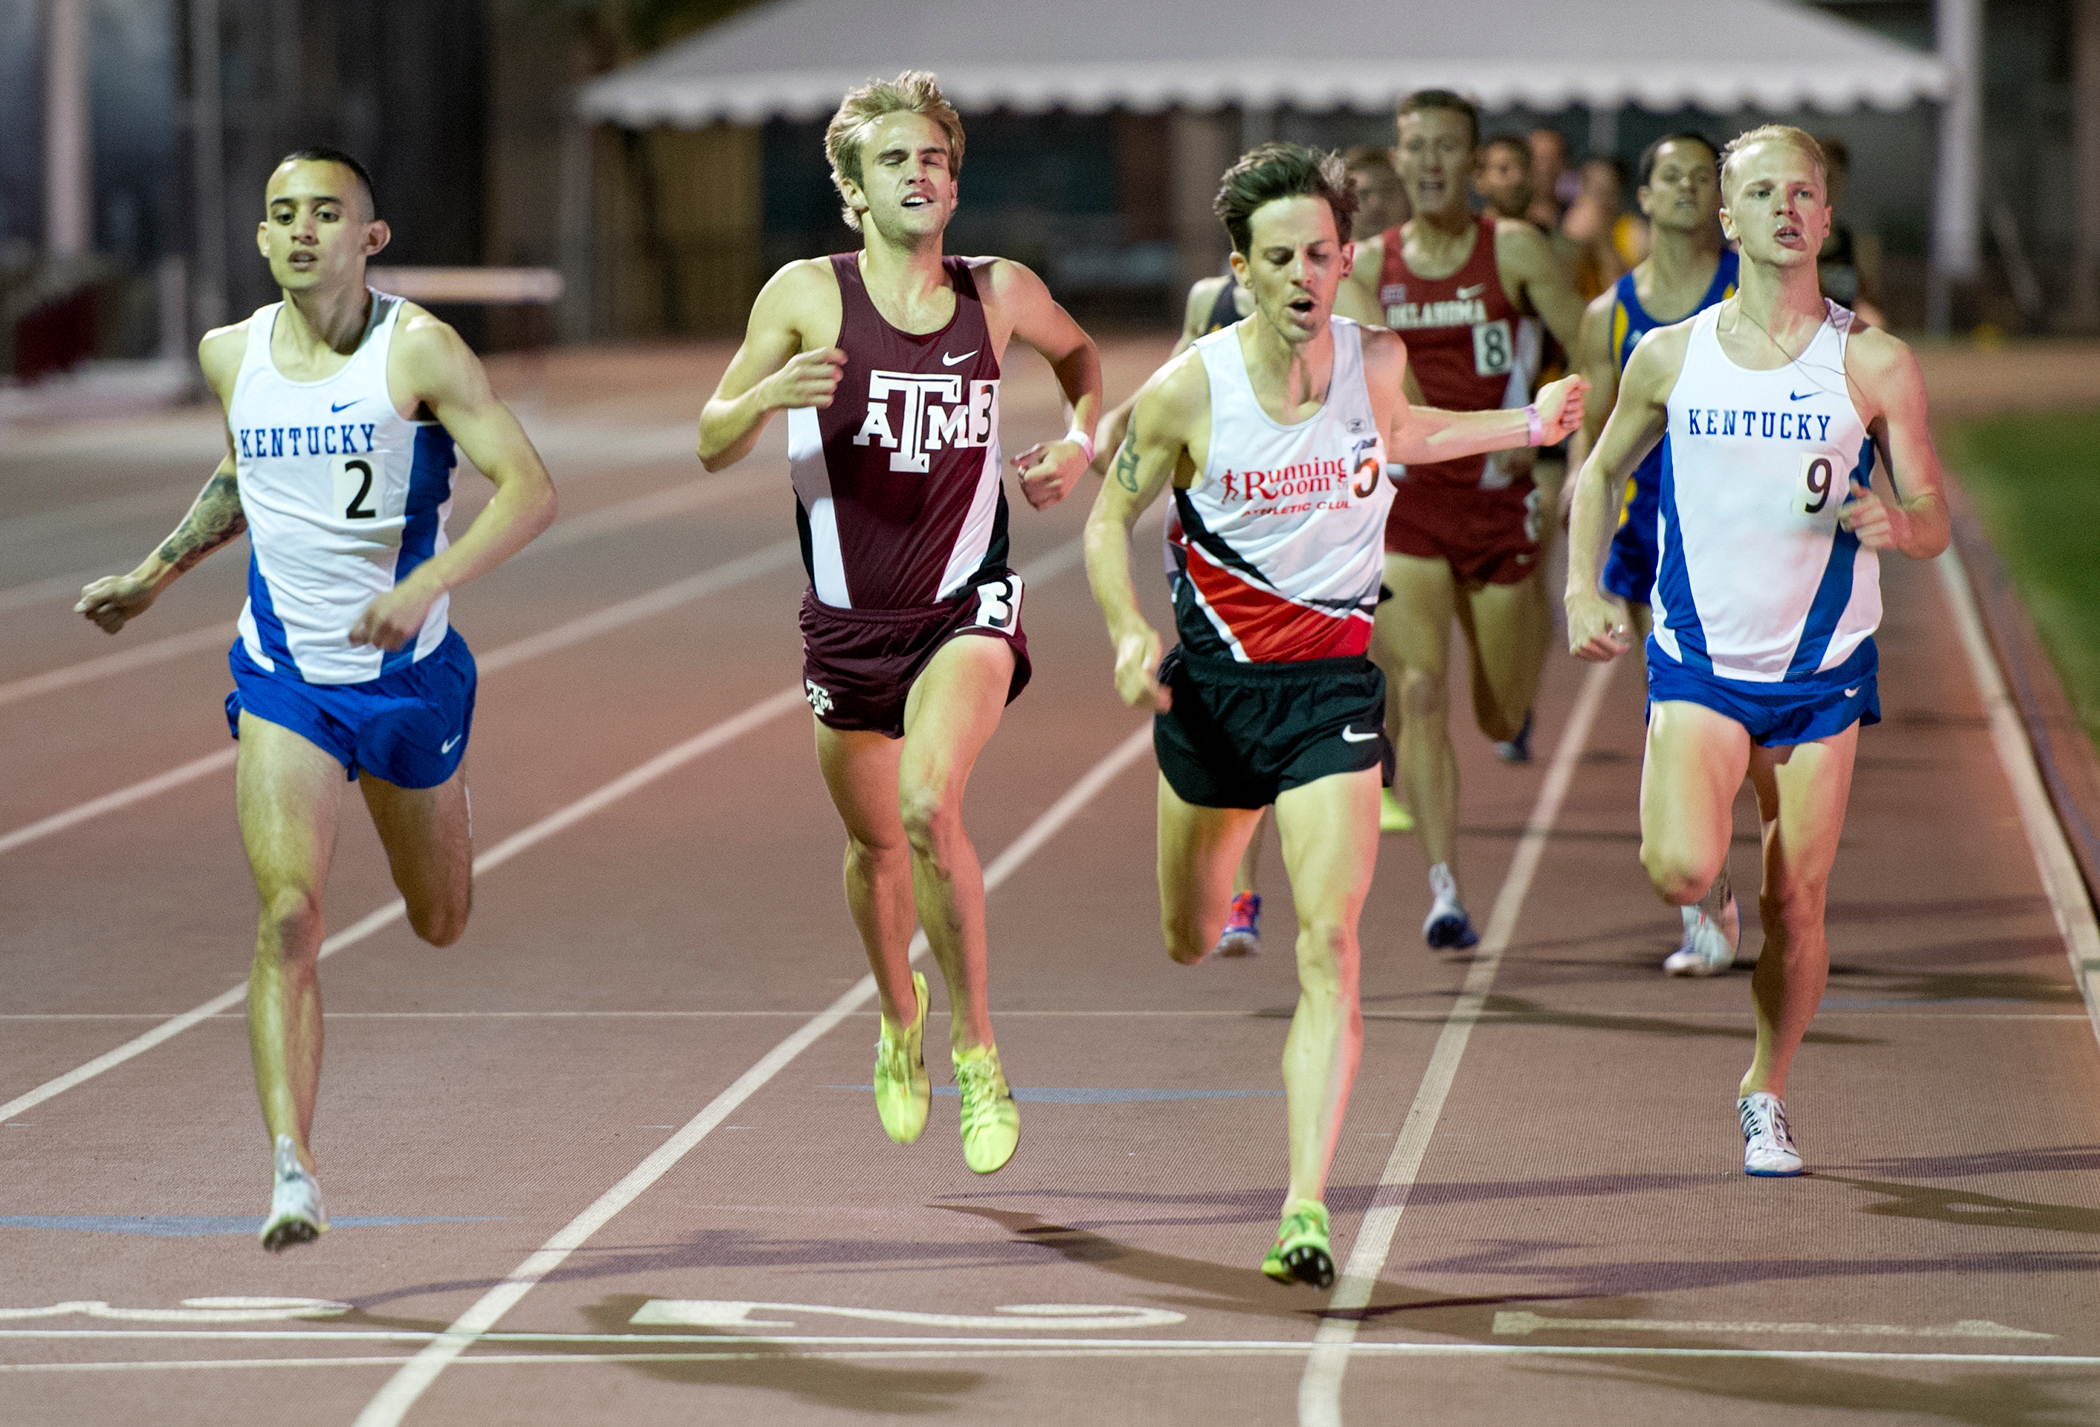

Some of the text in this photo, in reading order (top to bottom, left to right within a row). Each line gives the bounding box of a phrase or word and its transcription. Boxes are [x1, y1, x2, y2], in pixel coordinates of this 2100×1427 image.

[1485, 329, 1506, 368] 8
[976, 384, 994, 443] 3
[1688, 409, 1831, 441] KENTUCKY
[240, 423, 375, 458] KENTUCKY
[345, 459, 376, 519] 2
[1352, 438, 1379, 498] 5
[1804, 458, 1832, 513] 9
[988, 578, 1013, 628] 3
